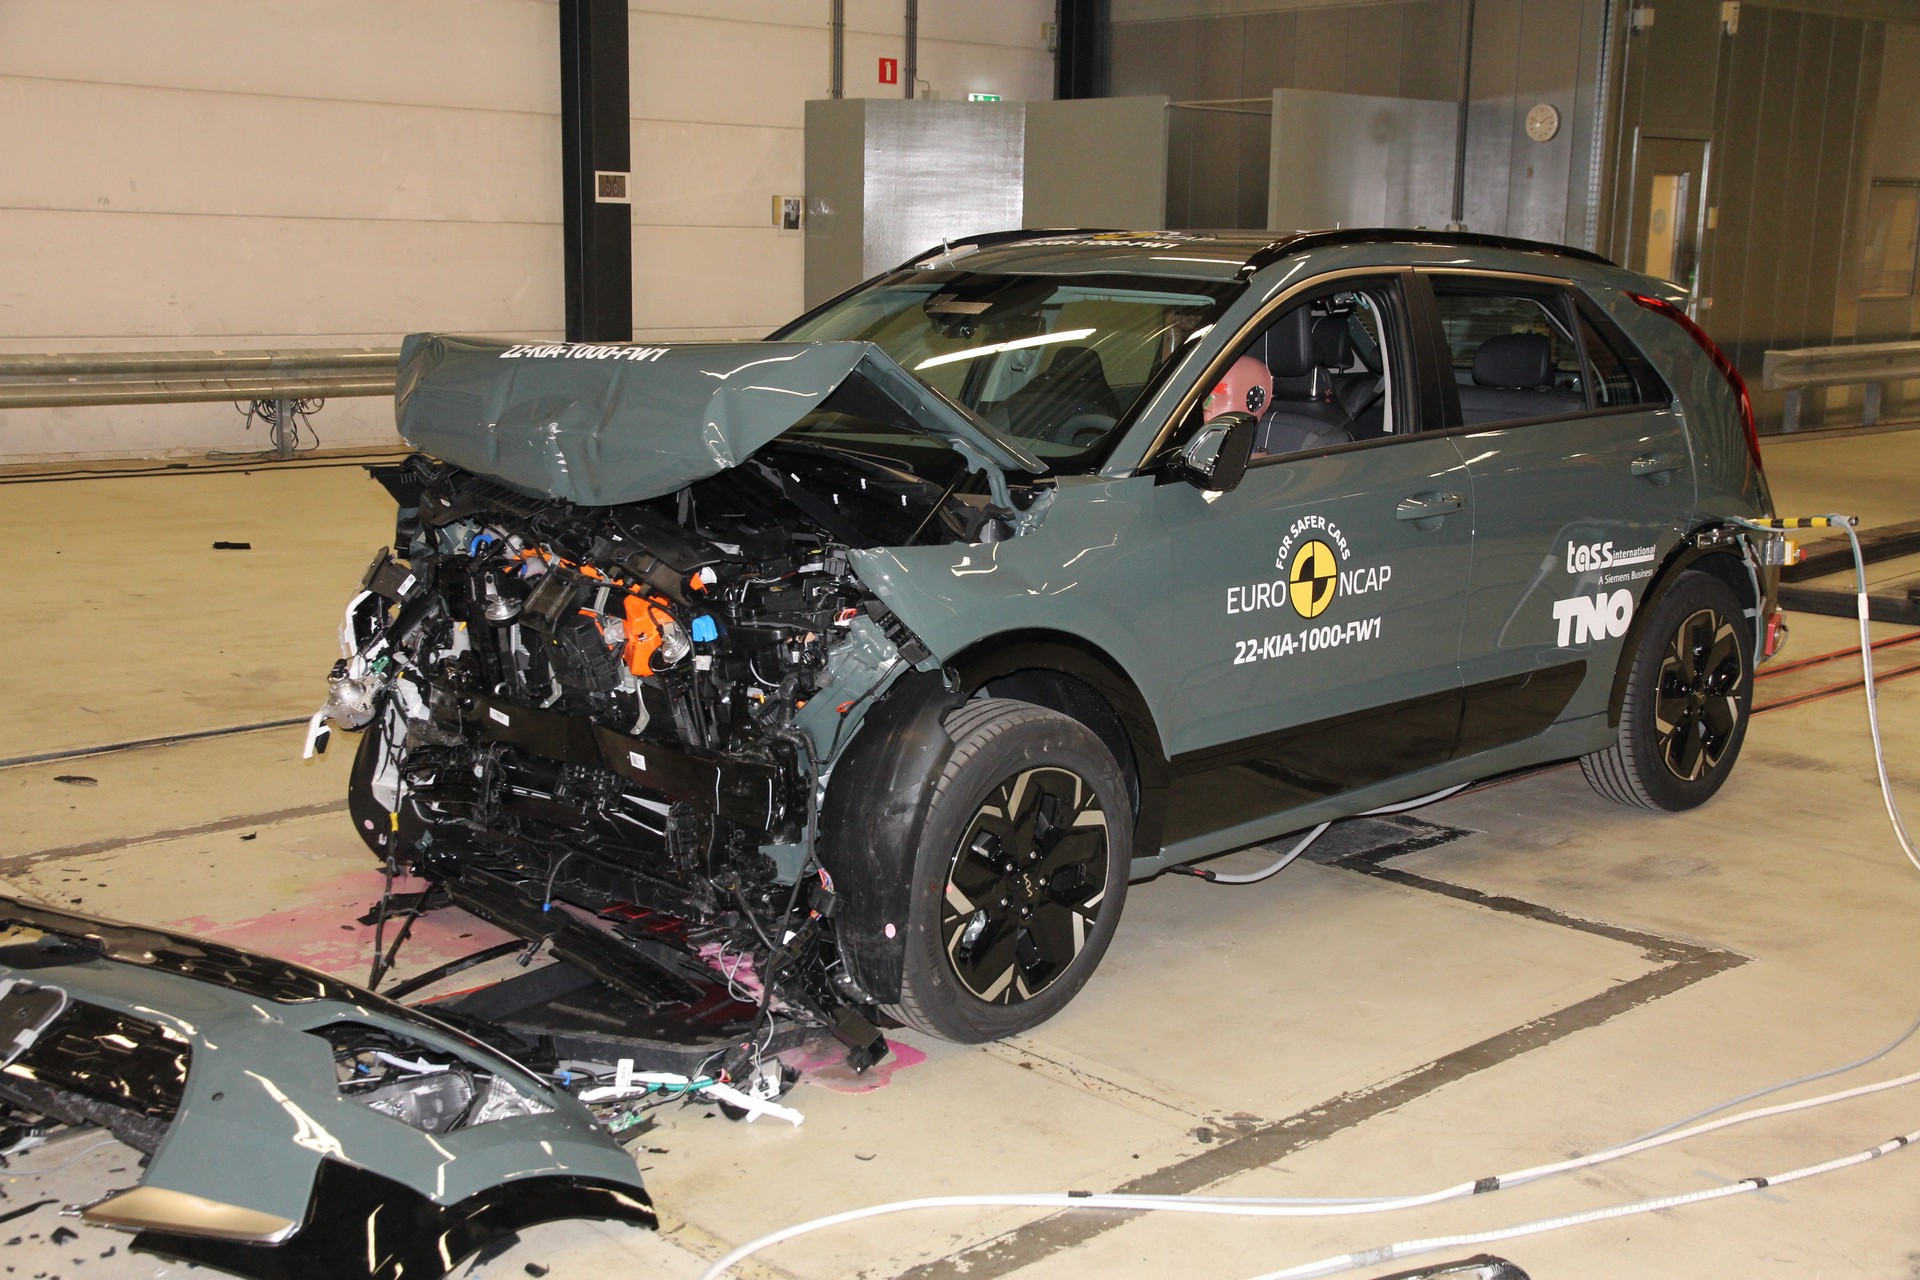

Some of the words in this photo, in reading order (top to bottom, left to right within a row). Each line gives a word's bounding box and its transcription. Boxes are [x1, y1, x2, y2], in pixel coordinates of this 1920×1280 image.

[499, 344, 671, 362] 22-KIA-1000-FW1
[1275, 535, 1294, 570] FOR
[1290, 515, 1326, 539] SAFER
[1327, 522, 1351, 561] CARS
[1566, 540, 1614, 574] tass
[1612, 544, 1656, 560] international
[1226, 580, 1287, 615] EURO
[1338, 565, 1392, 597] NCAP
[1598, 576, 1604, 585] A
[1604, 573, 1631, 585] Siemens
[1631, 568, 1654, 580] Business
[1233, 616, 1382, 665] 22-KIA-1000-FW1
[1552, 588, 1634, 648] TNO
